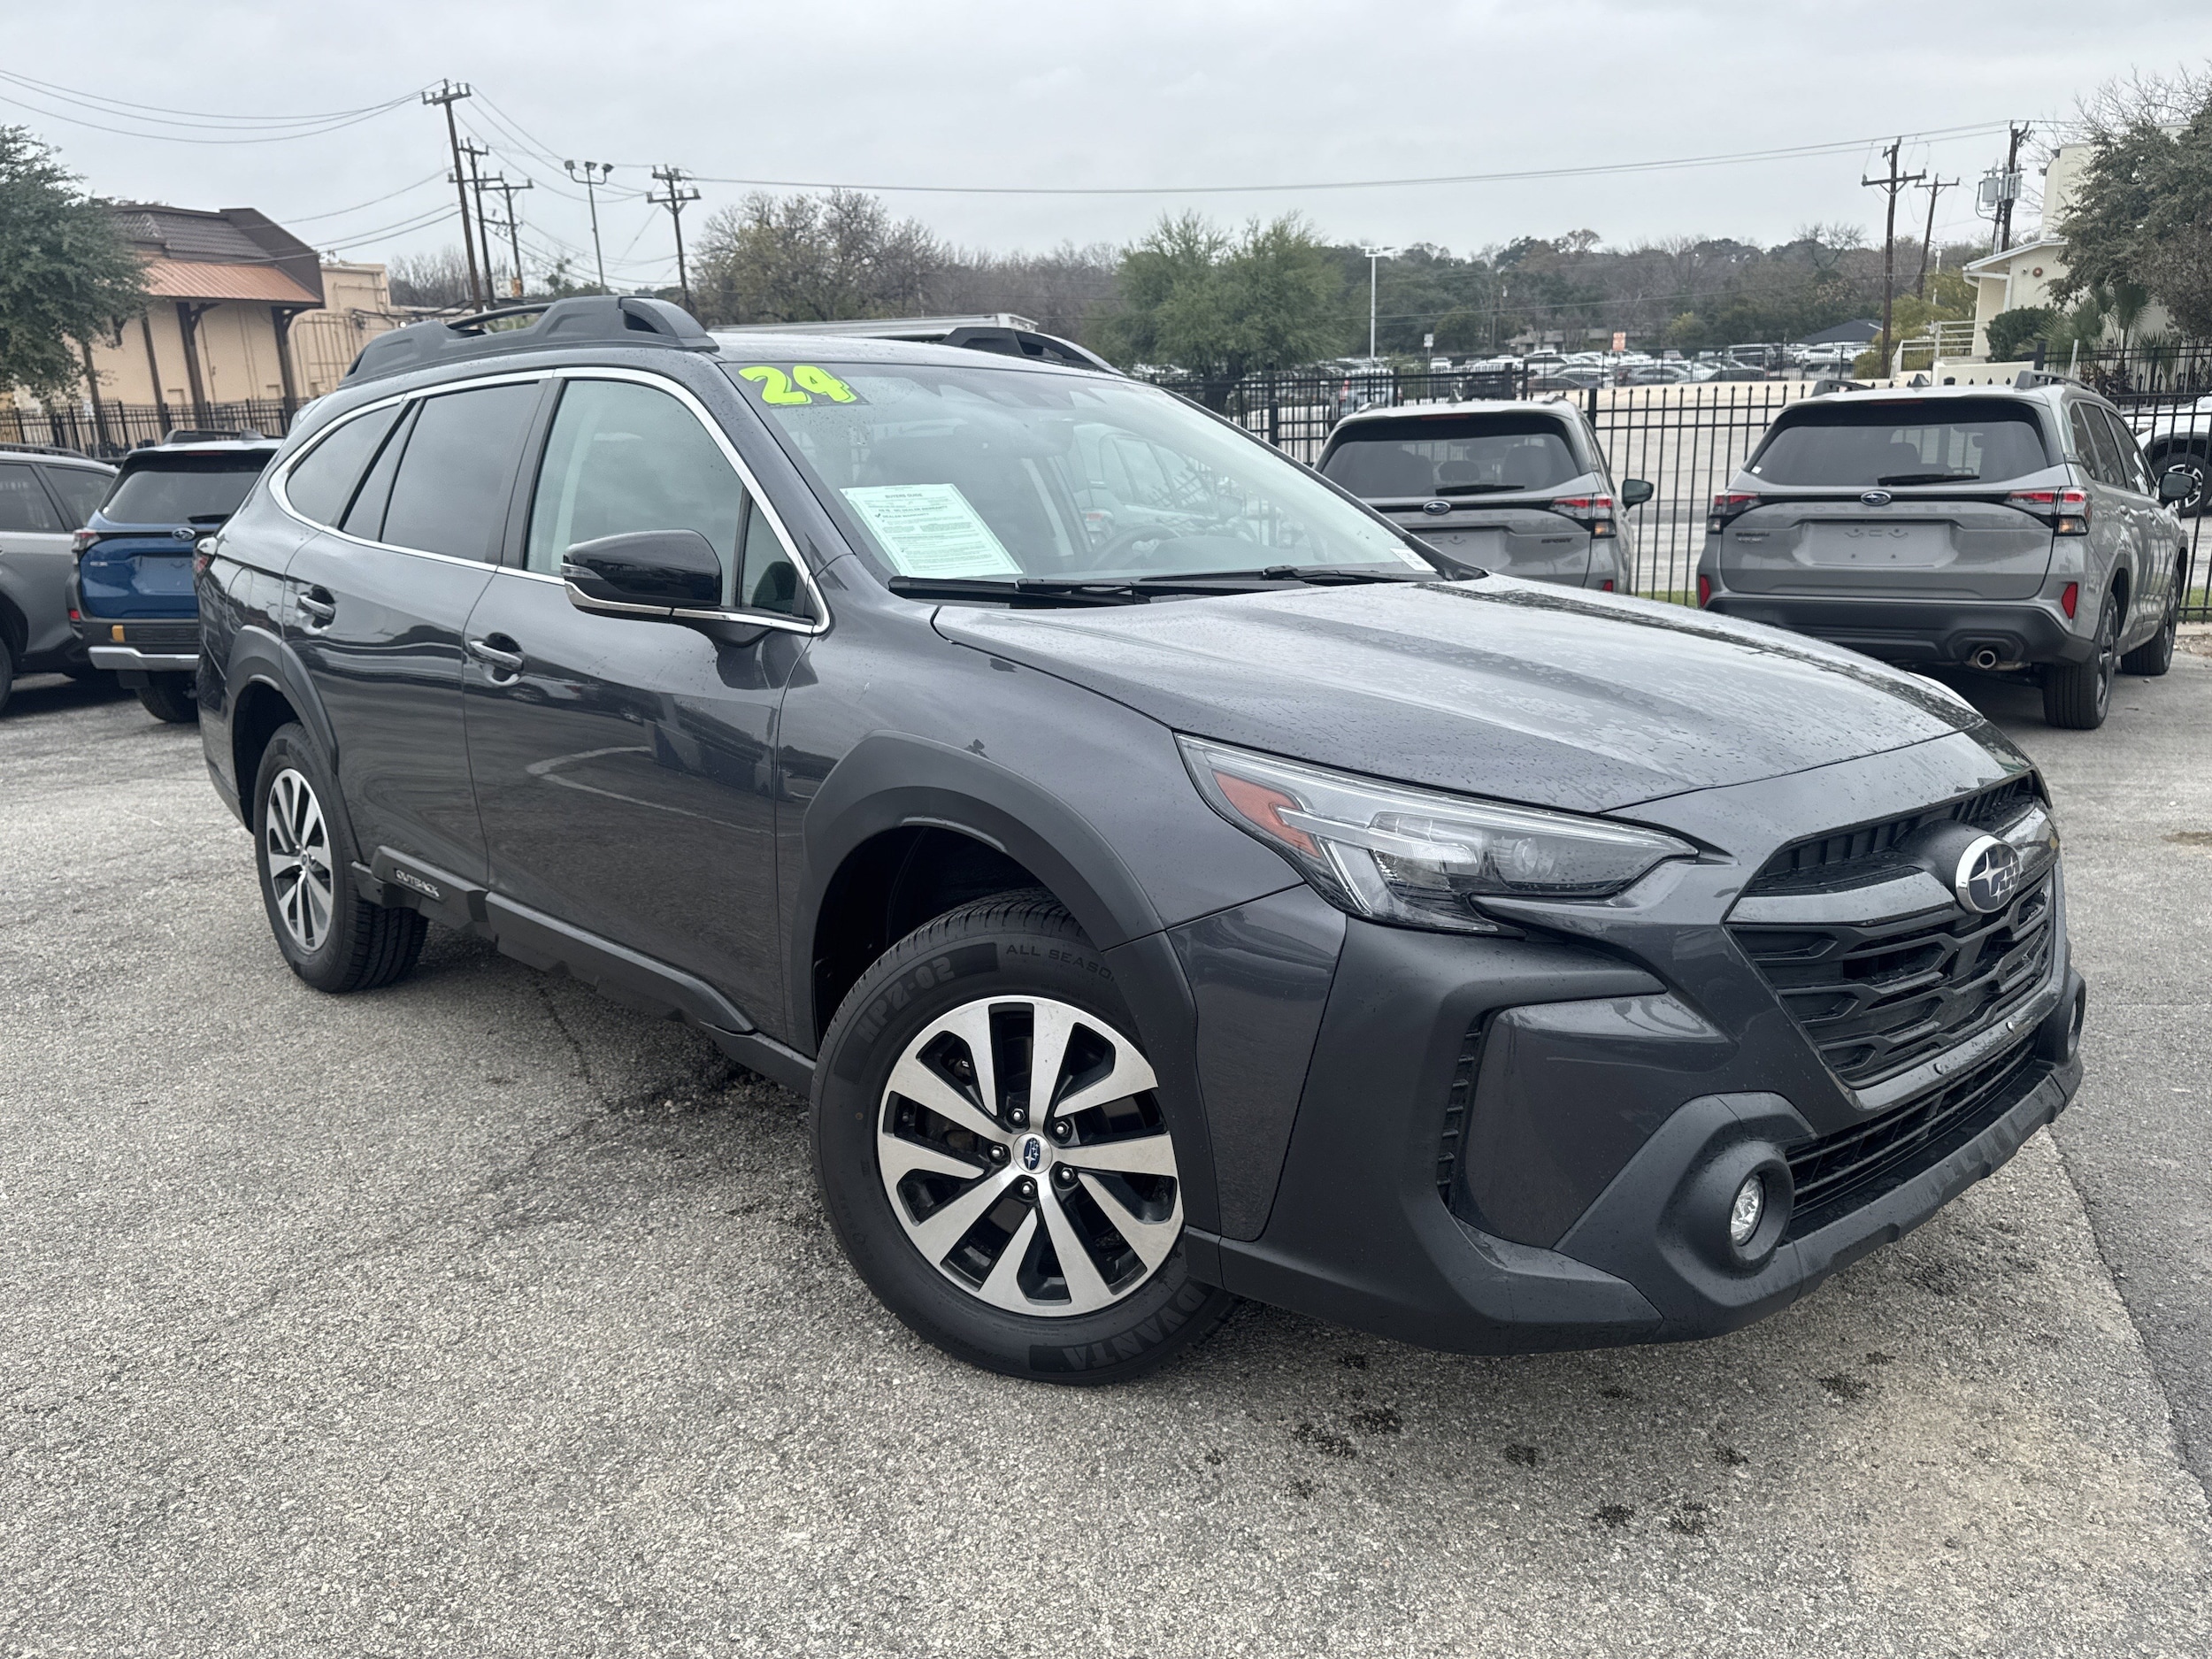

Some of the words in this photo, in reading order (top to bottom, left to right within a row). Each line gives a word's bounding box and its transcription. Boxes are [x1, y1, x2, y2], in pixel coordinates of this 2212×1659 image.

[739, 365, 857, 404] 24
[396, 869, 440, 898] OUTBACK
[1006, 944, 1041, 956] ALL
[1048, 949, 1115, 983] SEASO
[855, 956, 956, 1044] HPZ-02
[1062, 1282, 1207, 1371] DVANTA
